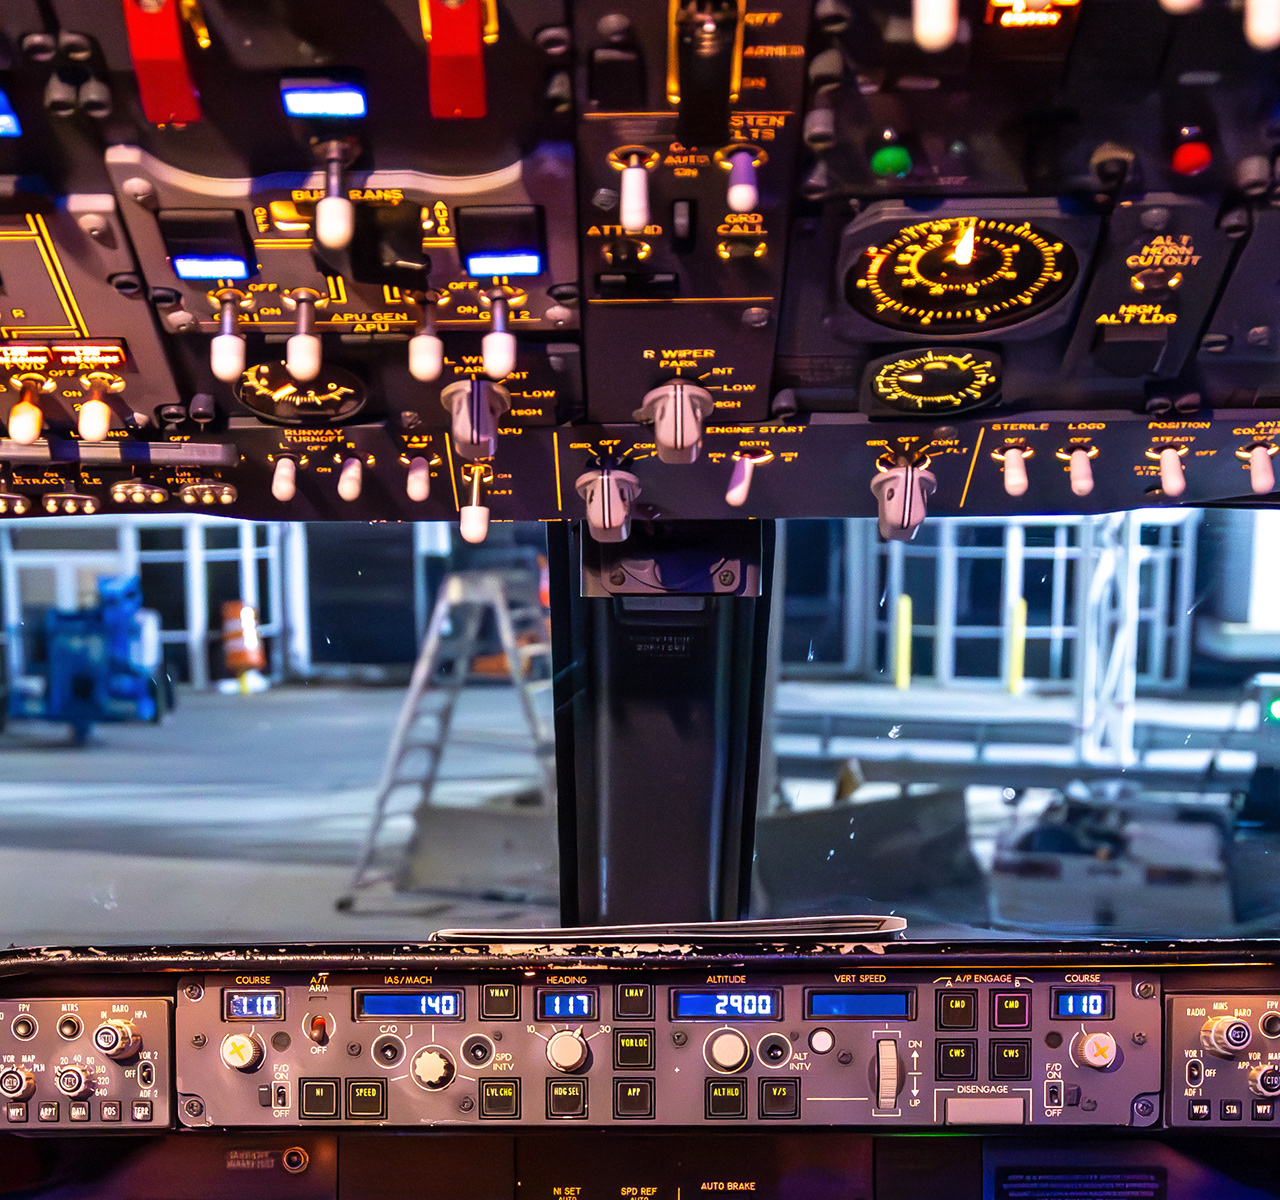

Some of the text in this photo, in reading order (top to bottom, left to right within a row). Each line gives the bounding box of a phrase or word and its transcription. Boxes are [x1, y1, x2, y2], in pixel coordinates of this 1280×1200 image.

[717, 225, 767, 233] CALL
[1126, 255, 1202, 266] CUTOUT
[248, 283, 277, 292] OFF
[1118, 304, 1161, 314] HIGH
[331, 313, 407, 322] APU GEN
[1096, 313, 1177, 323] ALT LDG
[354, 323, 389, 332] APU
[643, 349, 715, 358] R WIPER
[49, 369, 75, 377] OFF
[723, 384, 756, 392] LOW
[63, 390, 82, 398] ON
[523, 390, 555, 398] LOW
[706, 426, 756, 434] ENGINE
[1148, 422, 1211, 430] POSITION
[236, 976, 270, 984] COURSE
[310, 976, 327, 984] A/T
[384, 976, 432, 984] IAS/MACH
[547, 976, 587, 985] HEADING
[706, 975, 746, 984] ALTITUDE
[834, 974, 886, 983] VERT SPEED
[955, 974, 1012, 983] A/P ENGAGE
[1065, 974, 1100, 982] COURSE
[309, 984, 329, 992] ARM
[625, 988, 643, 997] LNAV
[490, 989, 509, 998] VNAV
[19, 1004, 30, 1012] FPV
[62, 1004, 78, 1012] MTRS
[112, 1004, 129, 1012] BARO
[420, 995, 454, 1015] 140
[554, 995, 589, 1015] 117
[716, 995, 770, 1015] 2900
[950, 1000, 965, 1009] CMD
[1068, 995, 1102, 1014] 110
[135, 1011, 147, 1019] HPA
[310, 1046, 327, 1055] OFF
[949, 1049, 965, 1058] CWS
[355, 1088, 376, 1097] SPEED
[957, 1086, 1008, 1094] DISENGAGE
[701, 1182, 755, 1190] AUTO BRAKE
[621, 1187, 657, 1195] SPD REF
